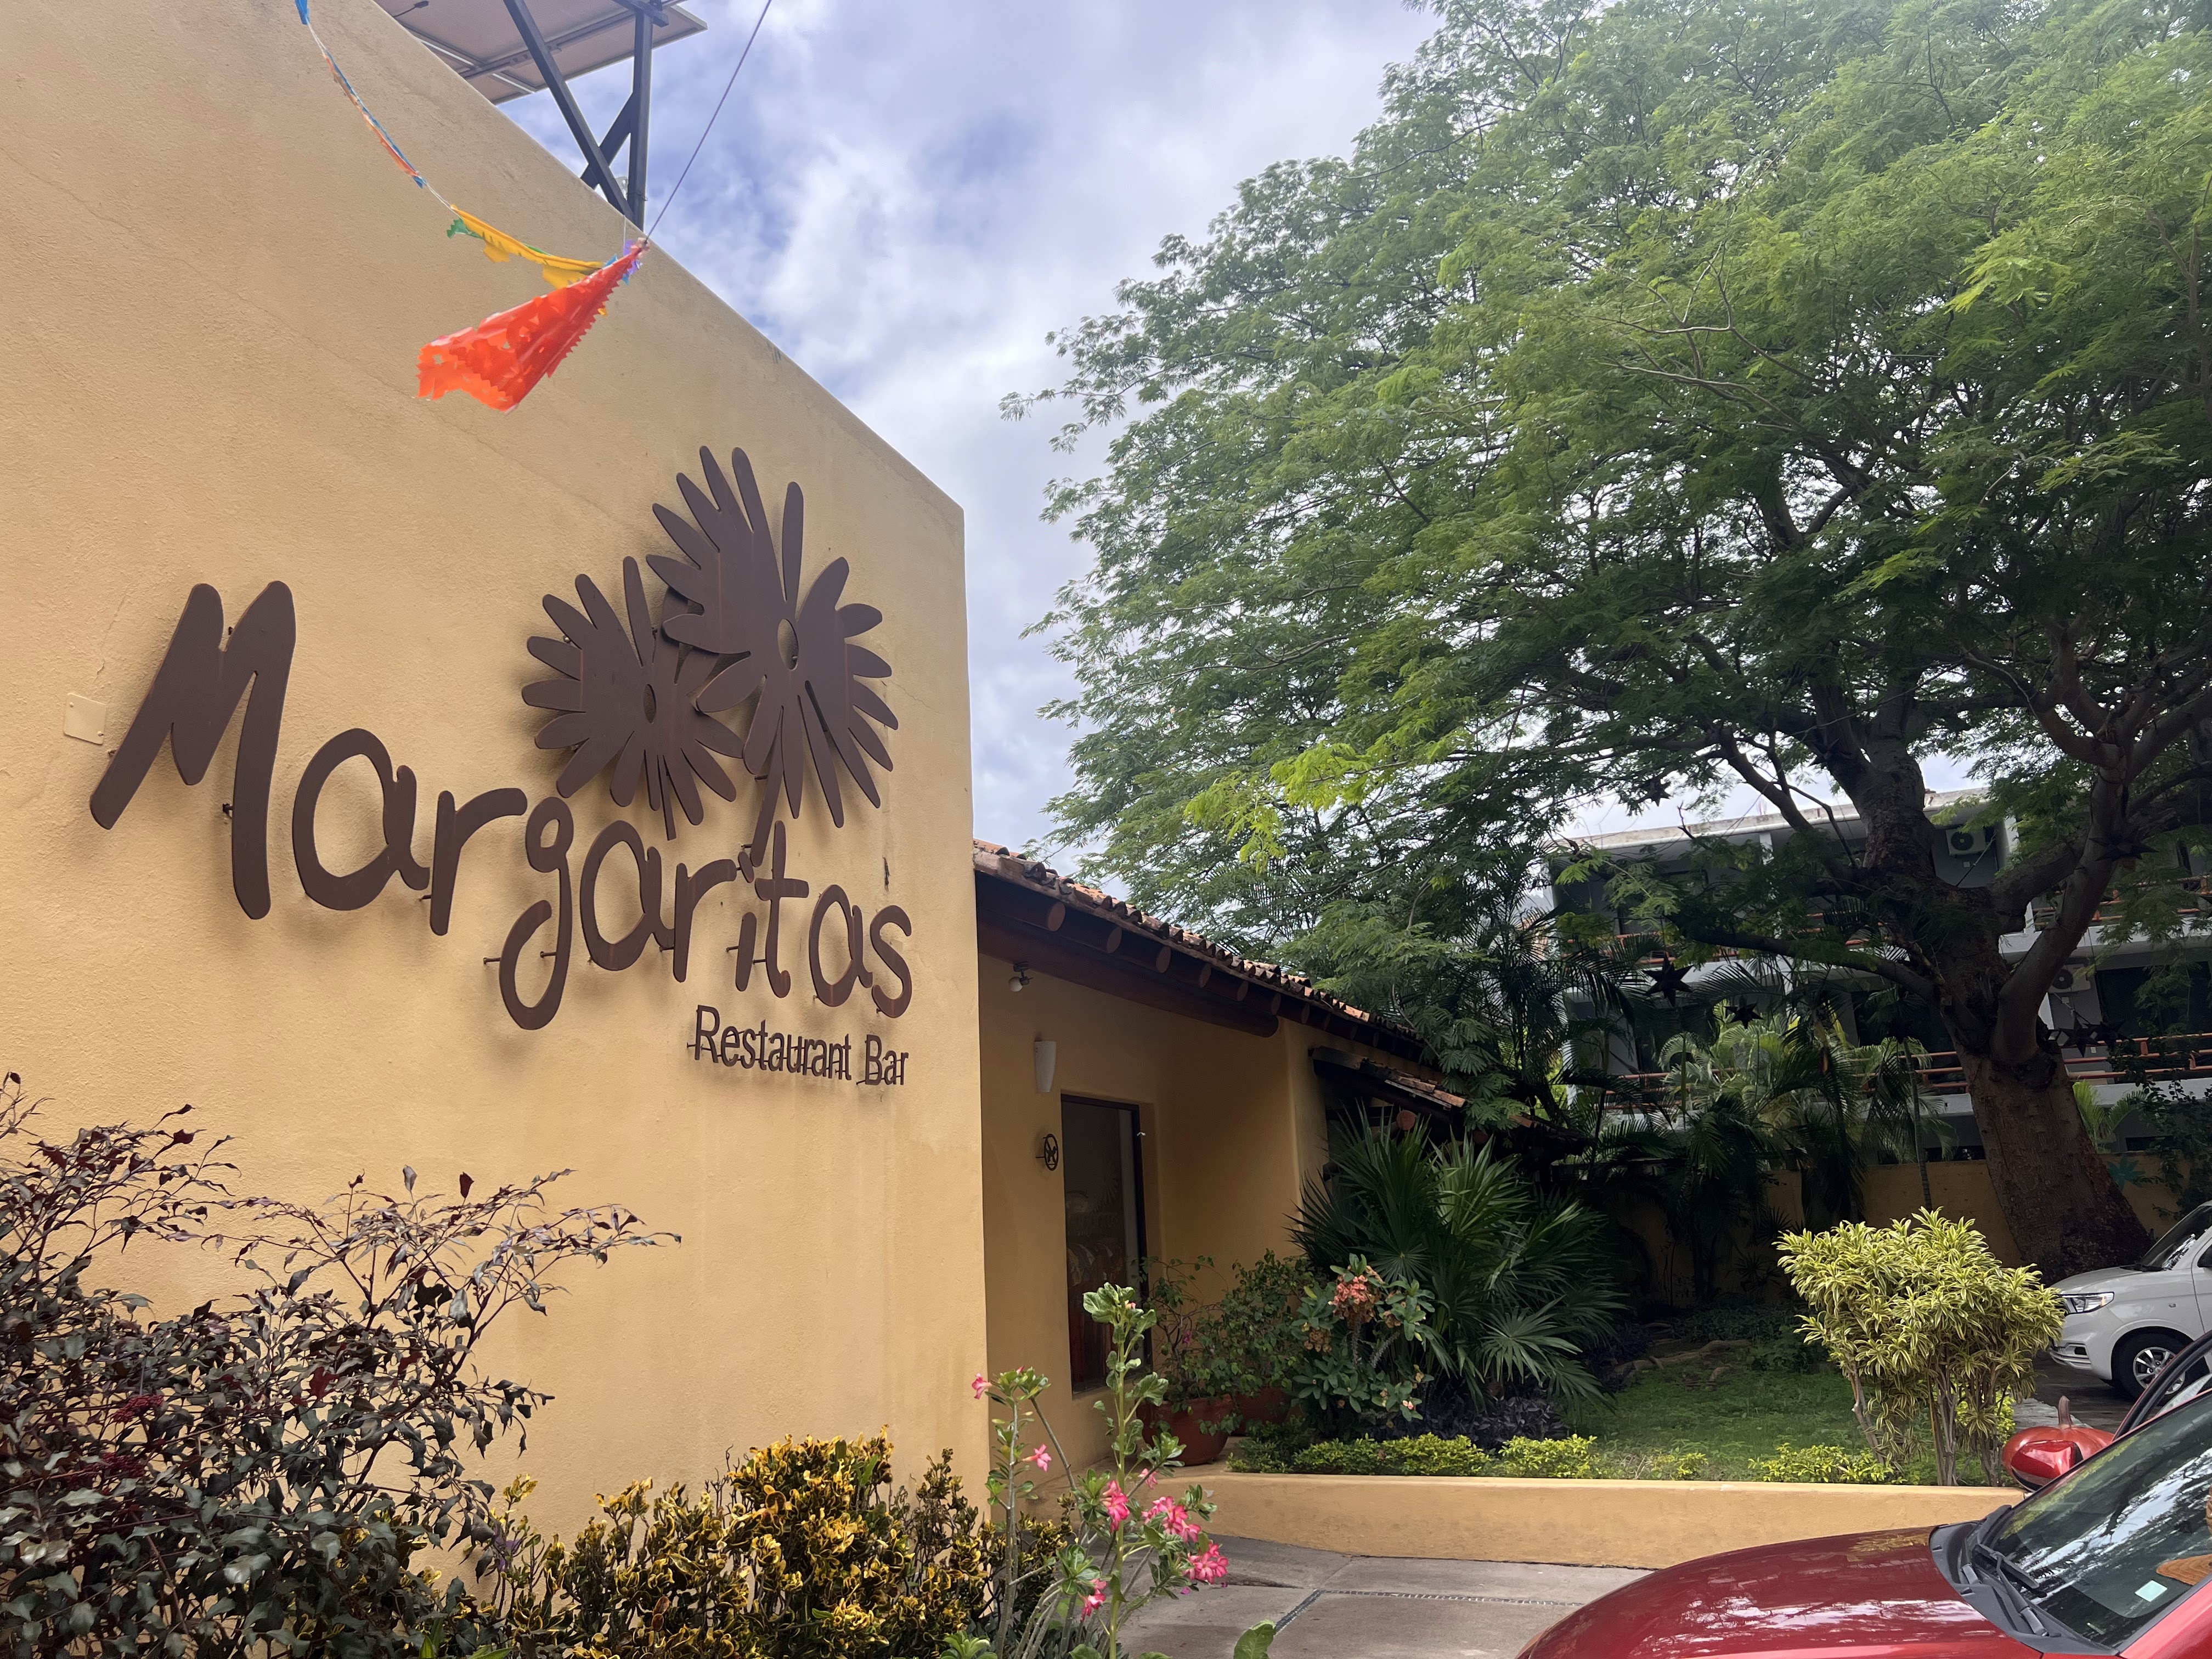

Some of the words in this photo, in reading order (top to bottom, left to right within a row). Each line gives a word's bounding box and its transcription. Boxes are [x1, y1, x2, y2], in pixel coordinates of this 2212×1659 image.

[90, 580, 912, 1030] Margaritas
[694, 1005, 851, 1080] Restaurant
[865, 1034, 909, 1086] Bar
